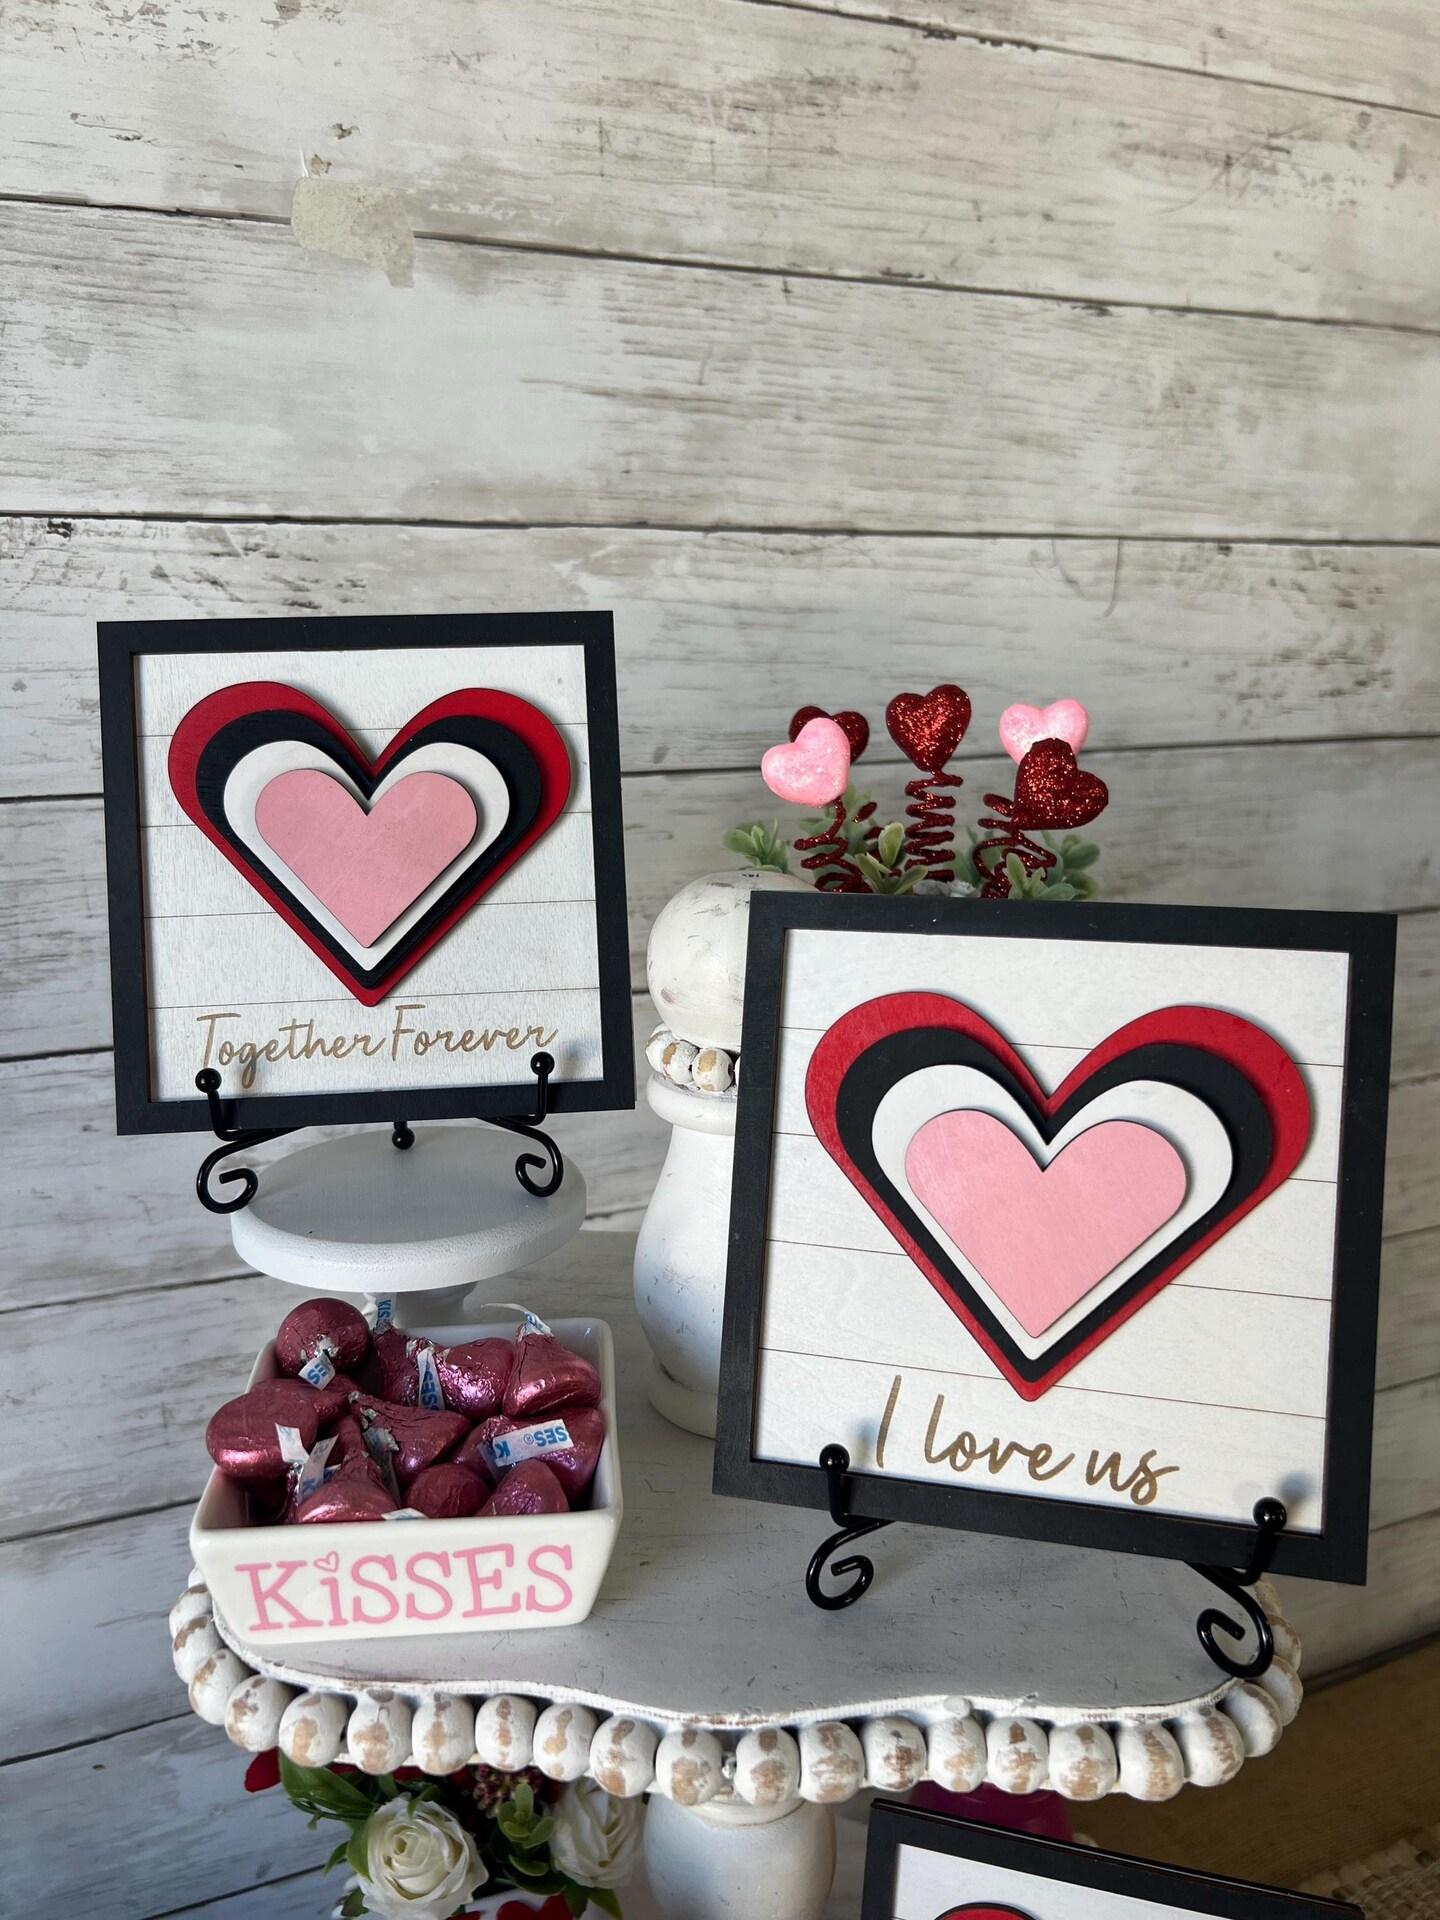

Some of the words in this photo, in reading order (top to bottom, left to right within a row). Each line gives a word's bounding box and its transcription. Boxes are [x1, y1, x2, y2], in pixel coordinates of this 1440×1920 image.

[196, 1012, 386, 1089] Together
[392, 1003, 559, 1062] Forever
[876, 1374, 902, 1469] I
[924, 1393, 1076, 1481] love
[1085, 1448, 1180, 1506] us
